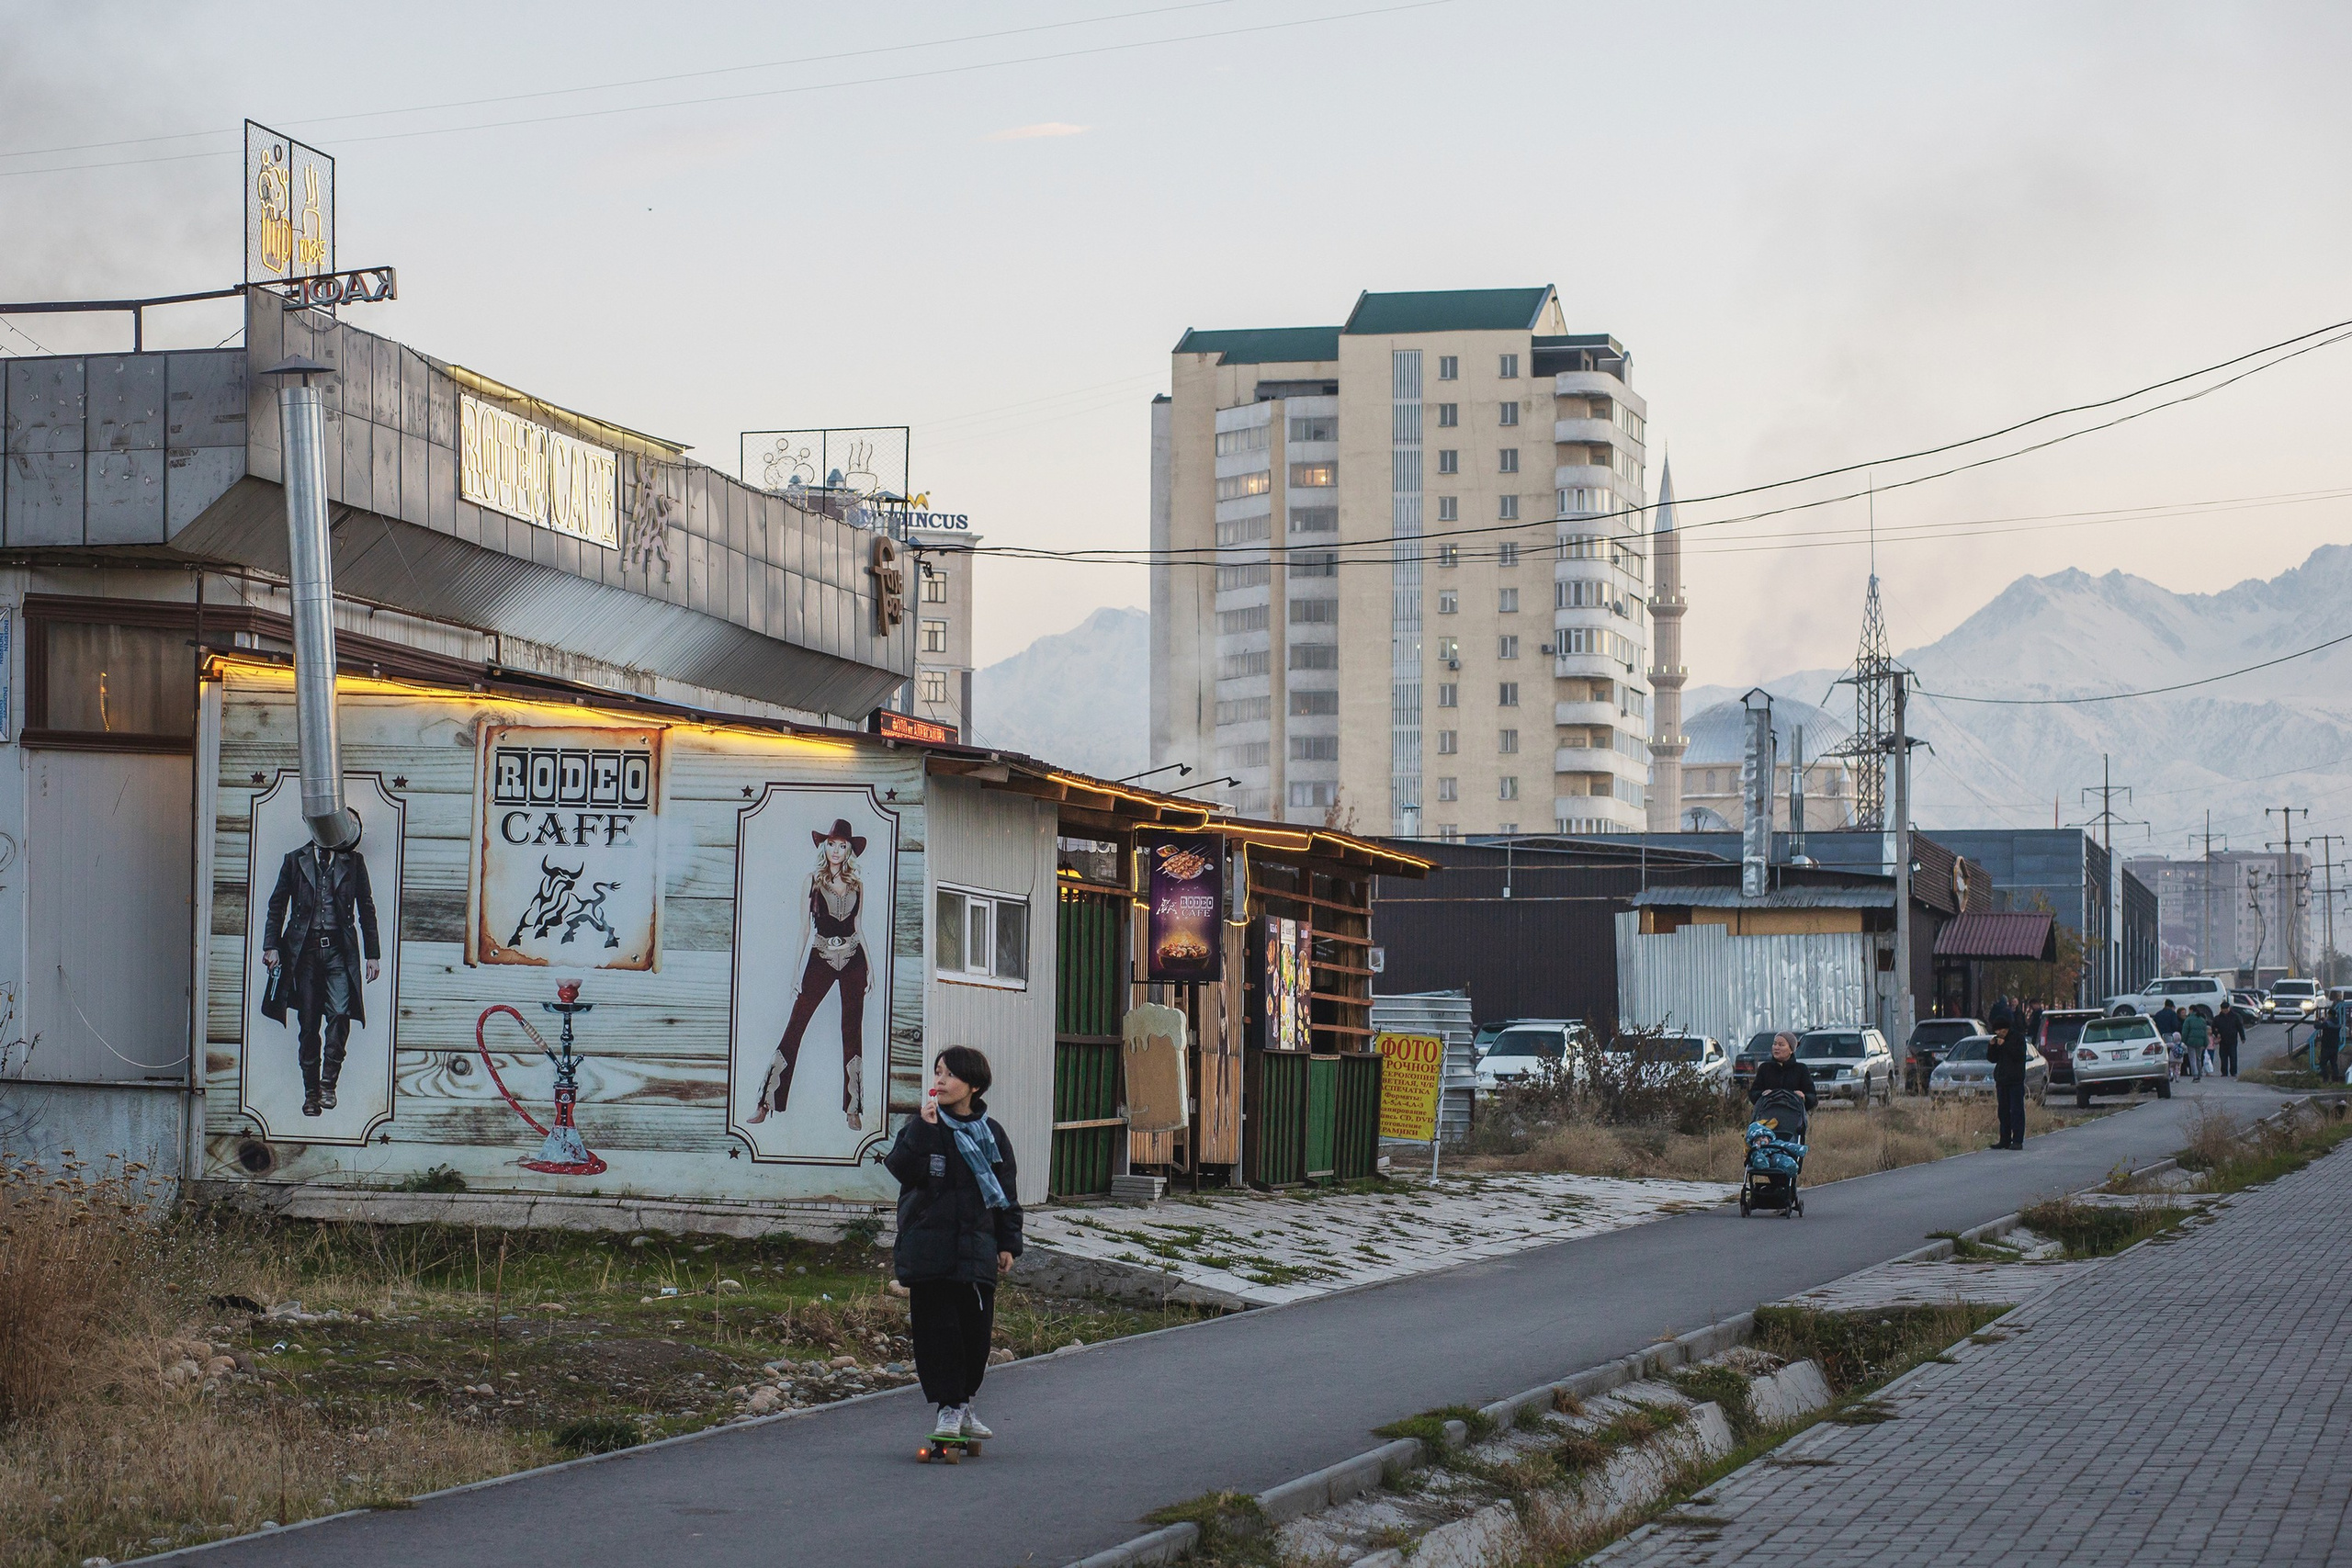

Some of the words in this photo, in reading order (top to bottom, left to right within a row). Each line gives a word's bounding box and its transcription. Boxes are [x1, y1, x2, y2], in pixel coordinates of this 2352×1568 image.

[460, 397, 548, 524] RODEO
[551, 434, 616, 544] CAFE
[496, 755, 647, 801] RODEO
[501, 811, 638, 848] CAFE
[1180, 897, 1214, 909] RODEO
[1182, 909, 1211, 918] CAFE
[1381, 1037, 1438, 1064] ФОТО
[1385, 1092, 1422, 1101] Форматы:
